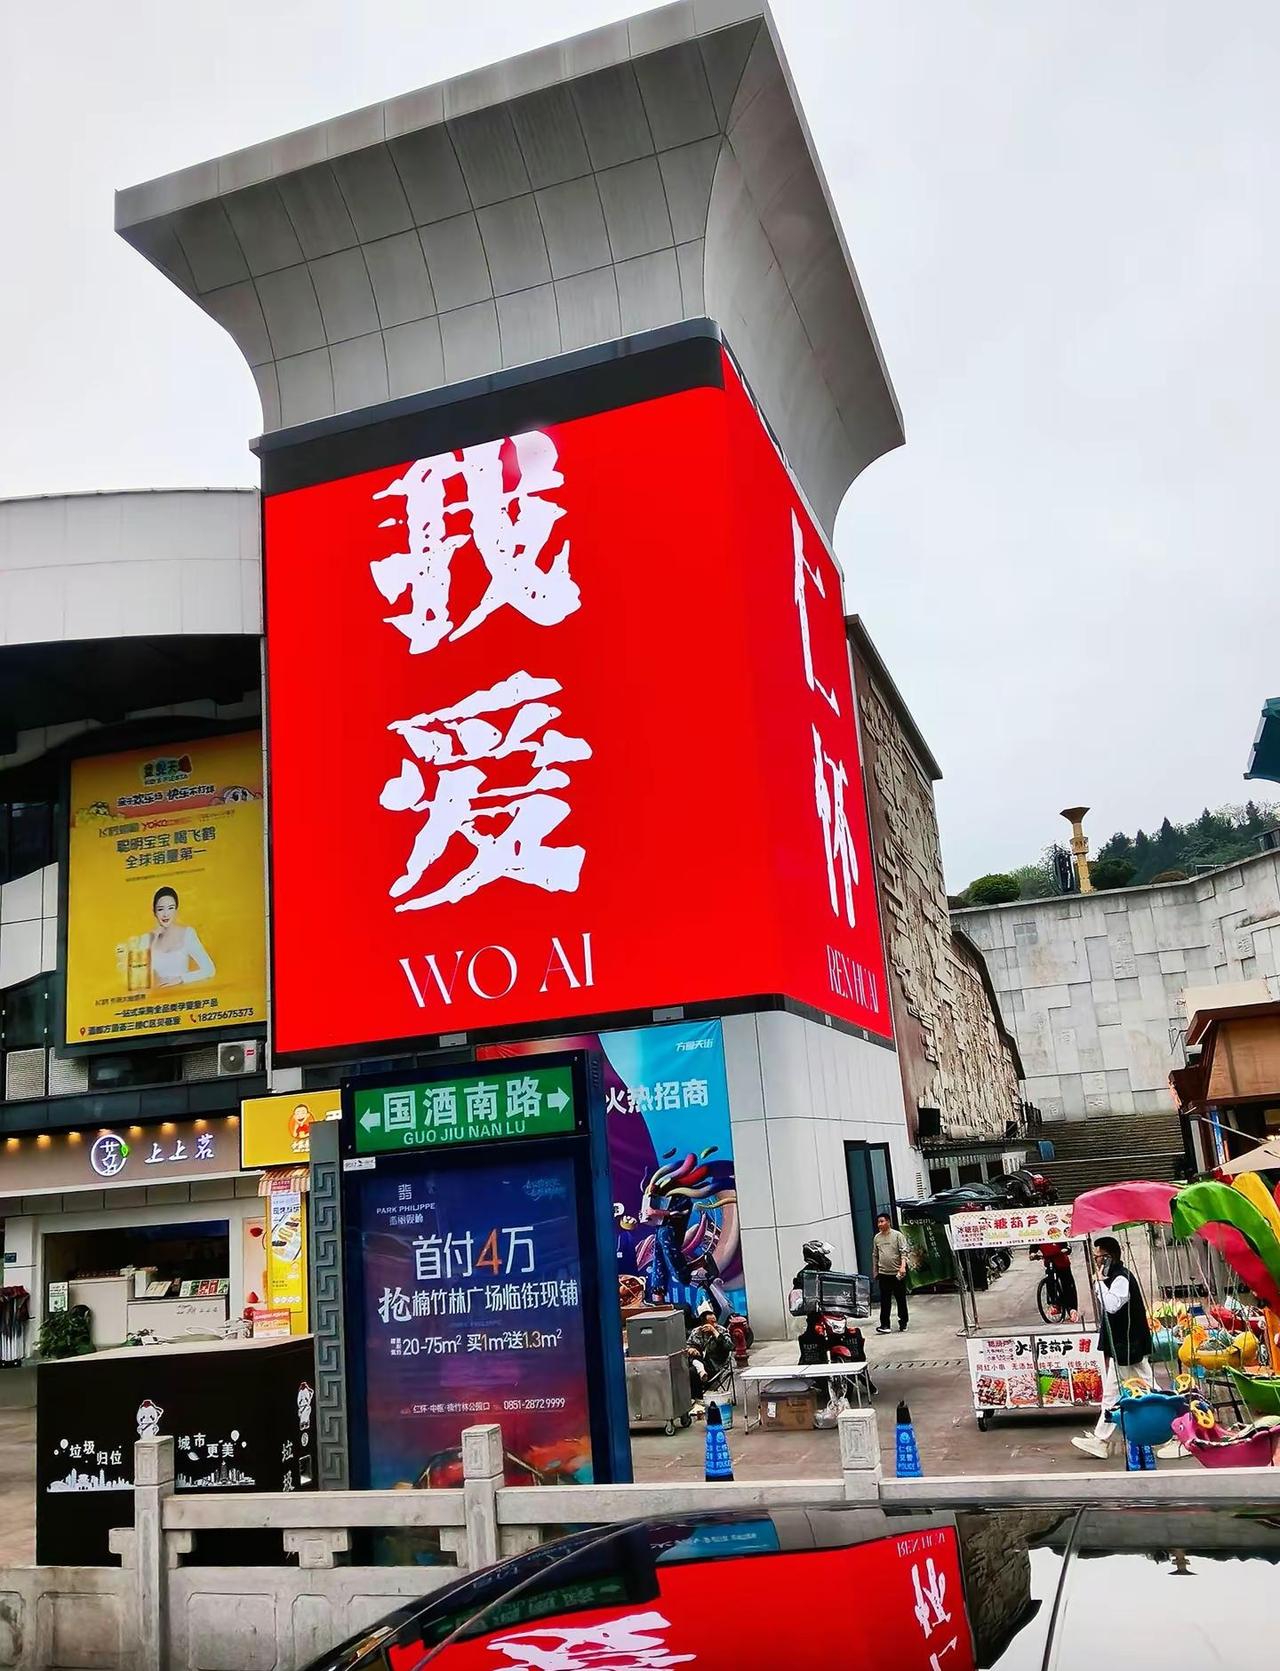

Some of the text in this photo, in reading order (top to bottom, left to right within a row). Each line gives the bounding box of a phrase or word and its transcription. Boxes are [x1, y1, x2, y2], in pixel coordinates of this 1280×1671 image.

[369, 430, 592, 913] 我爱
[125, 847, 208, 870] 全球销量第一
[399, 932, 594, 1009] WO AI
[383, 1076, 543, 1133] 国酒南路
[605, 1078, 709, 1115] 火热招商
[403, 1120, 527, 1146] GUO JIU NAN LU
[376, 1202, 436, 1215] PARK PHILIPPE
[412, 1226, 536, 1281] 首付4万
[68, 1432, 235, 1466] 垃圾归位 城市更美
